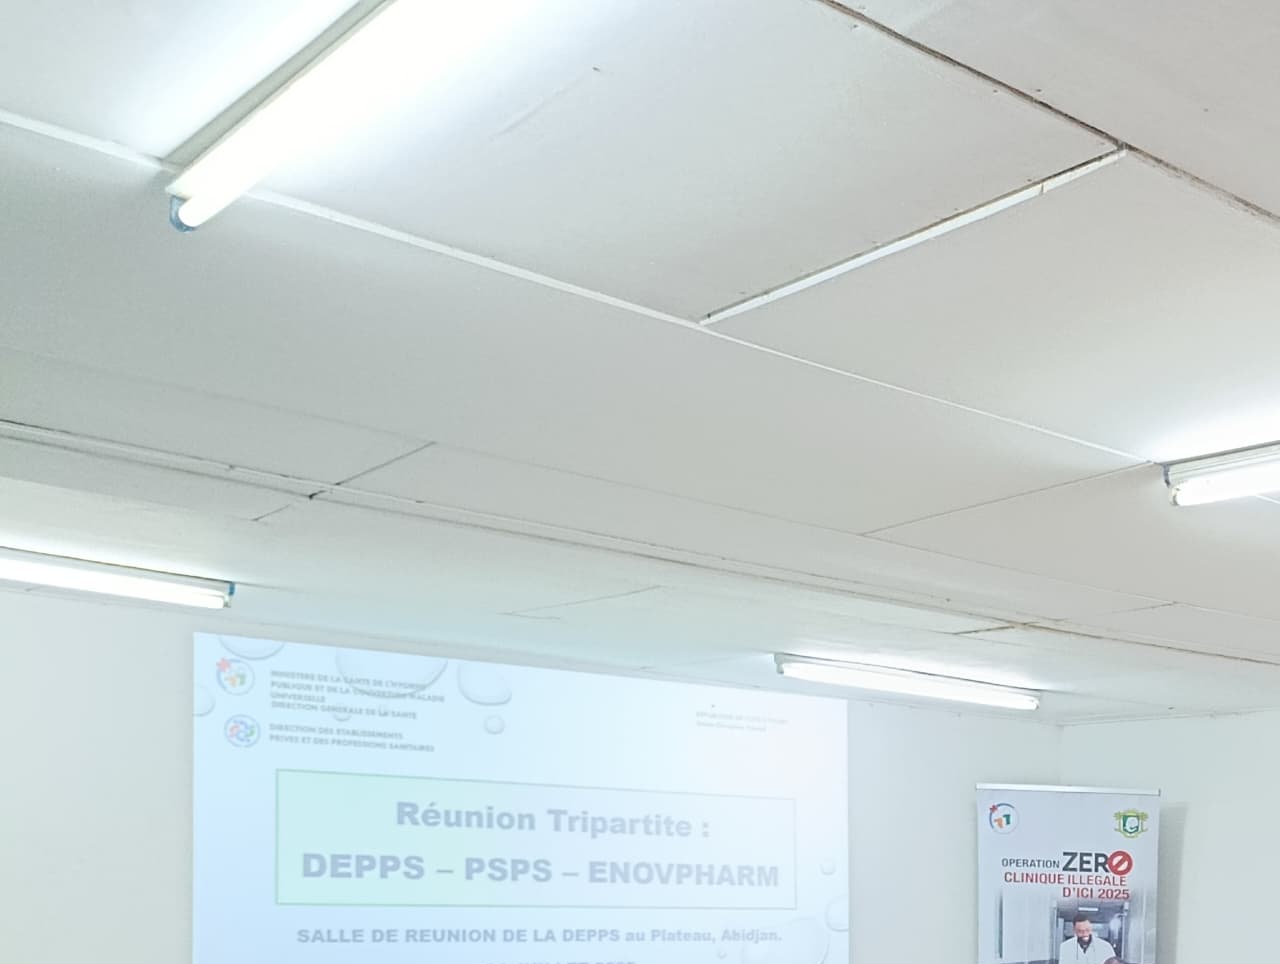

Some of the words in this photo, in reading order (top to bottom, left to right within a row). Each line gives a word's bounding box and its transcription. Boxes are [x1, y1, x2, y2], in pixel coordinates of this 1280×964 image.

[318, 674, 328, 682] DE
[330, 675, 341, 683] LA
[373, 679, 383, 687] DE
[315, 684, 324, 692] ET
[327, 685, 337, 693] DE
[271, 701, 318, 712] DIRECTION
[366, 708, 376, 716] DE
[269, 723, 316, 733] DIRECTION
[318, 727, 333, 735] DES
[301, 736, 311, 744] ET
[313, 737, 329, 745] DES
[396, 801, 536, 831] Réunion
[547, 809, 692, 839] Tripartite
[1001, 858, 1060, 869] OPERATION
[302, 853, 425, 880] DEPPS
[465, 857, 552, 882] PSPS
[588, 860, 779, 888] ENOVPHARM
[1004, 871, 1064, 884] CLINIQUE
[1068, 874, 1126, 886] ILLEGALE
[1063, 887, 1093, 898] D'ICI
[1098, 888, 1129, 900] 2025
[297, 929, 364, 943] SALLE
[372, 929, 398, 943] DE
[405, 929, 496, 943] REUNION
[503, 929, 528, 943] DE
[533, 929, 556, 943] LA
[563, 929, 620, 943] DEPPS
[625, 931, 646, 943] au
[651, 929, 716, 945] Plateau,
